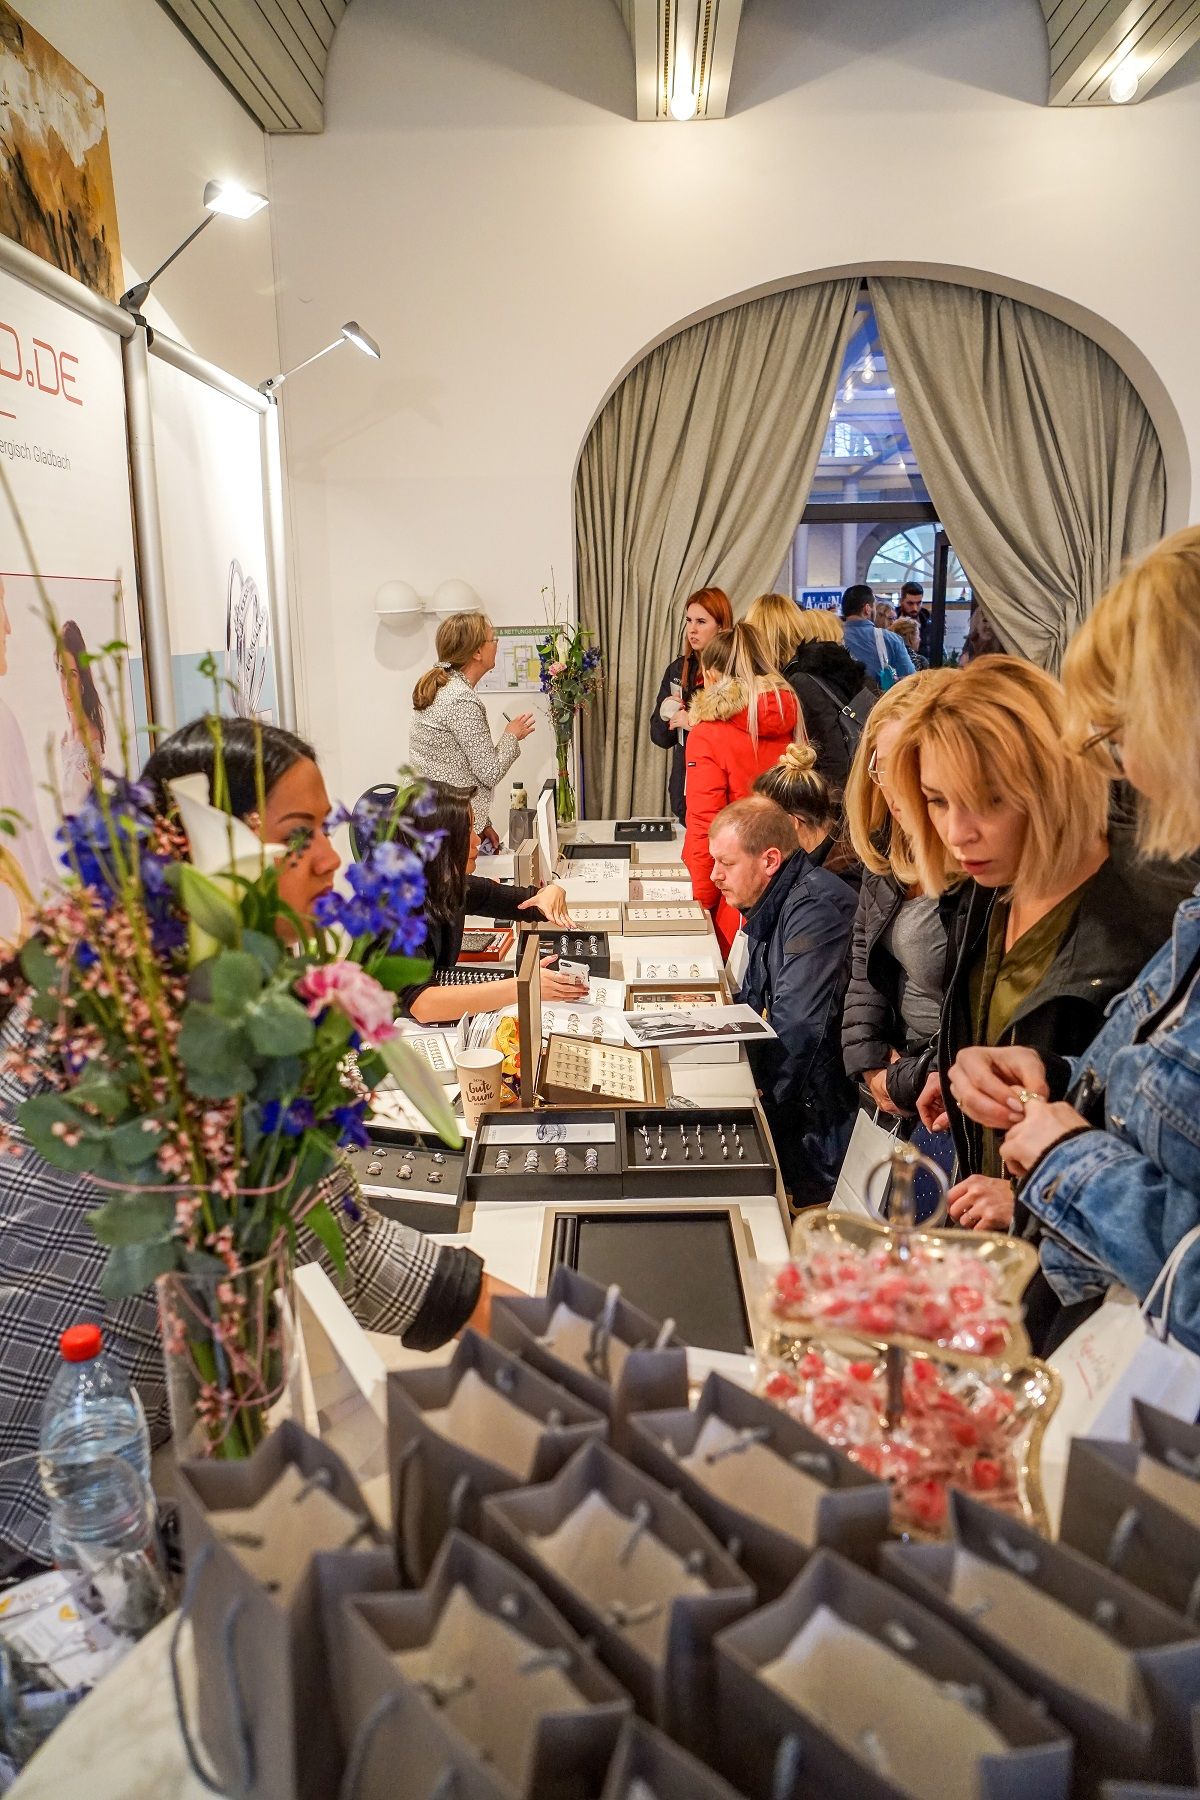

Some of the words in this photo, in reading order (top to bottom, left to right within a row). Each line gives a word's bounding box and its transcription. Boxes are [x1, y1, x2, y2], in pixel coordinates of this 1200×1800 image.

[33, 445, 72, 471] Gladbach
[468, 1080, 491, 1093] Gute
[466, 1091, 495, 1102] Laune
